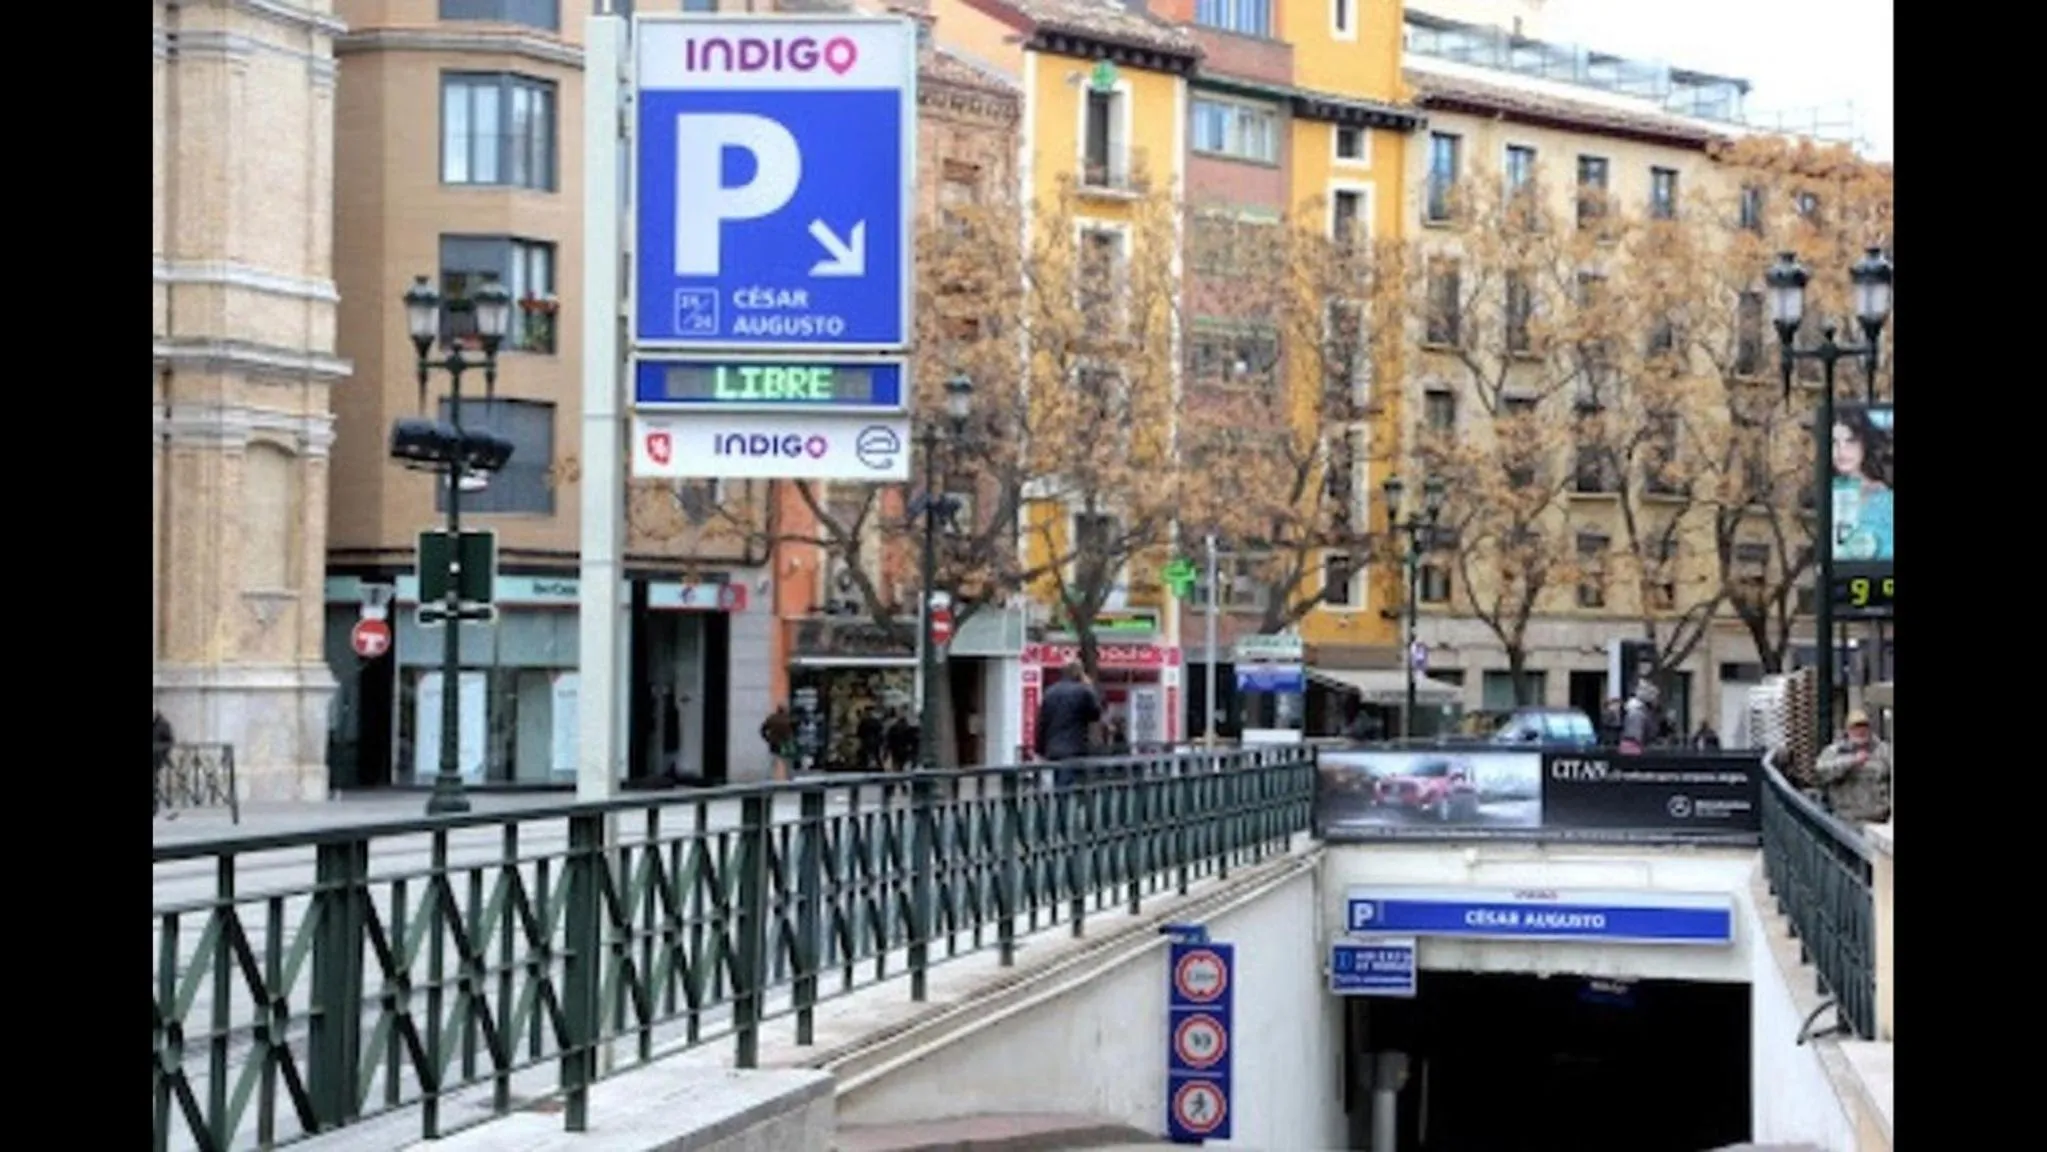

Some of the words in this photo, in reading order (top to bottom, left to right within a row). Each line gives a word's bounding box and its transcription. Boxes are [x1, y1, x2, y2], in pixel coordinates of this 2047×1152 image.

[685, 37, 858, 74] INDIGO
[674, 112, 802, 277] P
[732, 284, 810, 310] CÉSAR
[732, 314, 846, 337] AUGUSTO
[714, 366, 833, 400] LIBRE
[714, 433, 827, 459] INDIGO
[1354, 903, 1374, 928] P
[1465, 908, 1519, 926] CÉSAR
[1524, 911, 1606, 929] AUGUSTO
